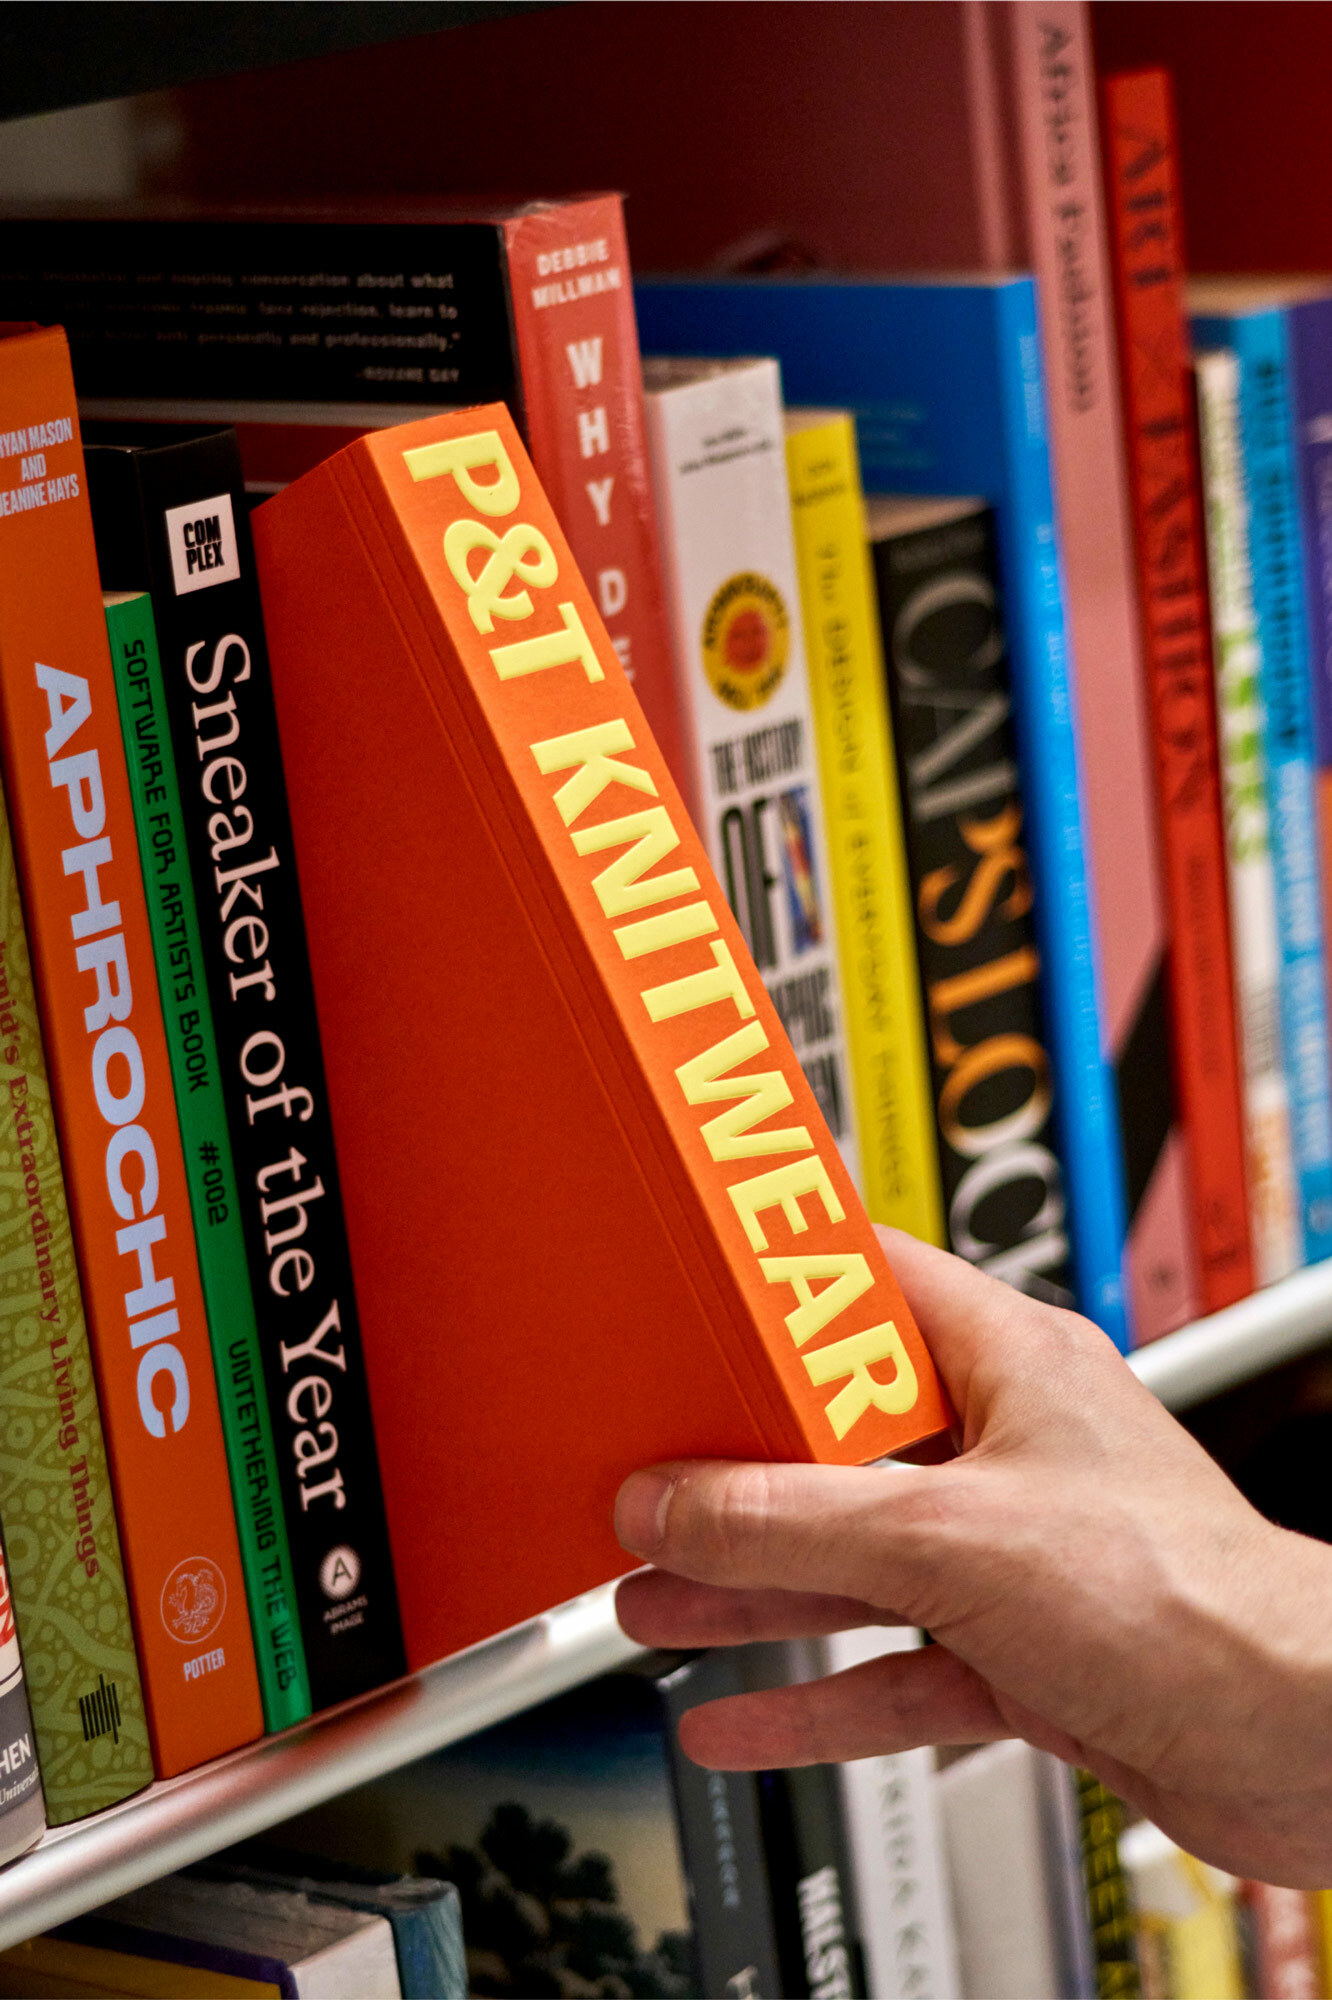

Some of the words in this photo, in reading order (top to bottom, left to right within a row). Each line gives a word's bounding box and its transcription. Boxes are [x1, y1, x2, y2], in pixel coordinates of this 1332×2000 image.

[356, 272, 404, 288] about
[410, 272, 454, 288] what
[532, 266, 622, 309] MILLMAN
[536, 239, 609, 277] DEBBIE
[439, 303, 458, 319] to
[21, 453, 47, 482] AND
[28, 417, 73, 451] MASON
[46, 473, 80, 504] HAYS
[183, 514, 222, 548] COM
[185, 540, 225, 576] PLEX
[124, 639, 168, 804] SOFTWARE
[149, 813, 171, 875] FOR
[185, 633, 281, 1002] Sneaker
[160, 883, 197, 1003] ARTISTS
[402, 430, 605, 684] P&T
[530, 718, 919, 1442] KNITWEAR
[34, 661, 191, 1439] APHROCHIC
[179, 1010, 210, 1093] BOOK
[239, 1030, 314, 1126] of
[199, 1140, 229, 1227] #002
[256, 1146, 326, 1297] the
[8, 1075, 62, 1325] Extraordinary
[49, 1334, 84, 1454] Living
[69, 1454, 100, 1580] Things
[228, 1339, 280, 1552] UNTETHERING
[280, 1299, 347, 1512] Year
[258, 1555, 287, 1611] THE
[183, 1646, 226, 1682] POTTER
[264, 1612, 297, 1692] WEB
